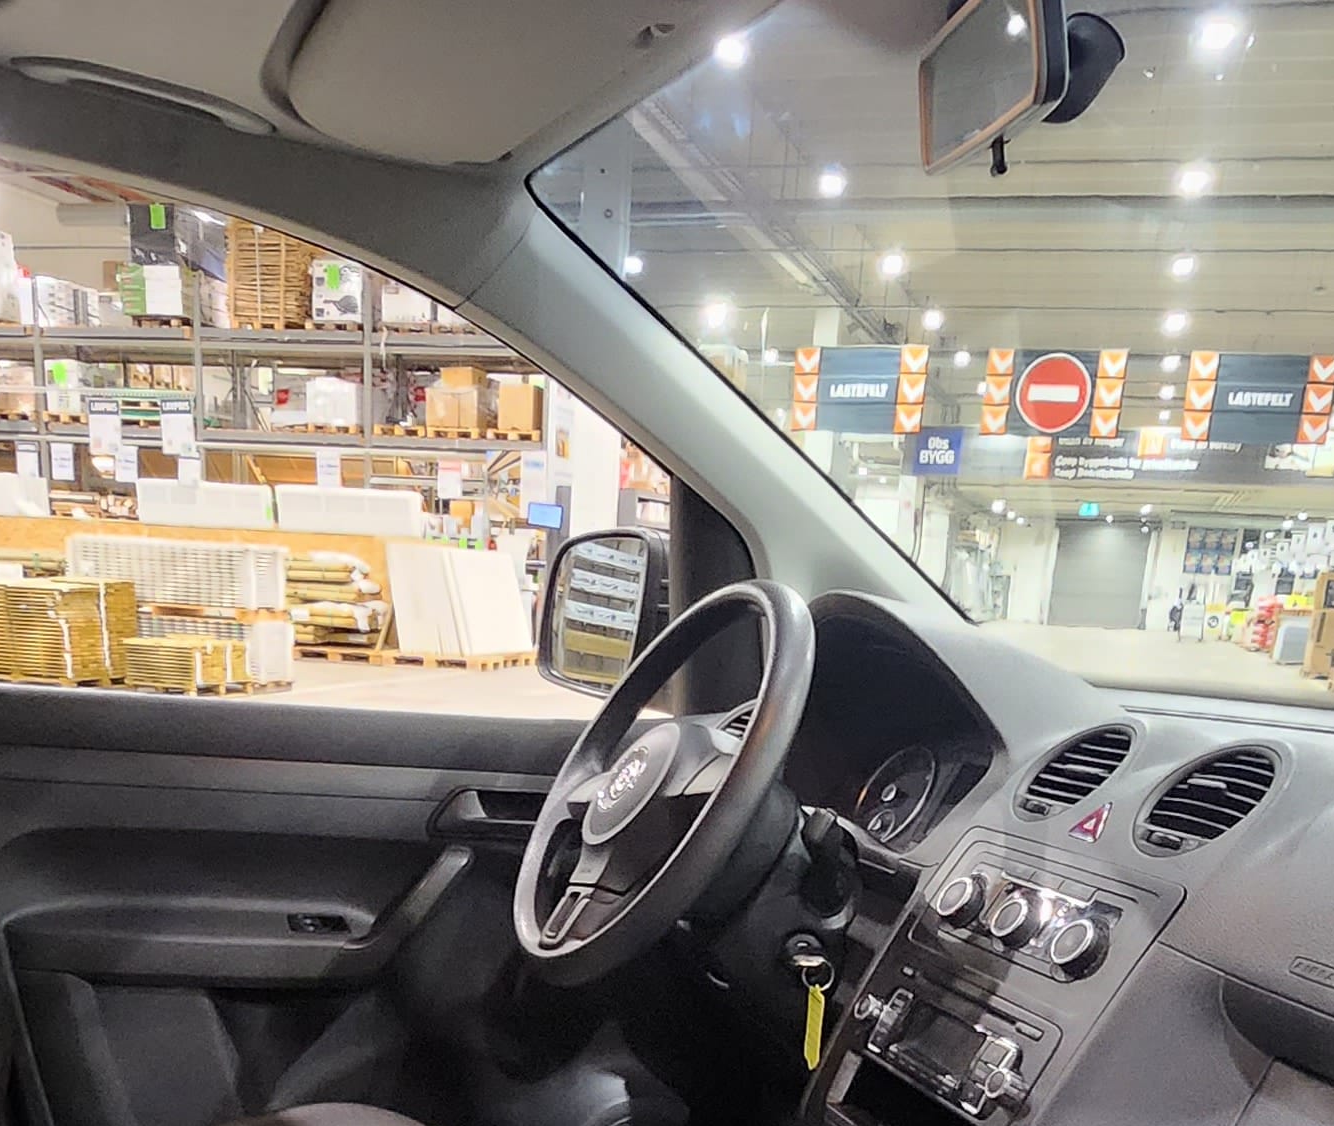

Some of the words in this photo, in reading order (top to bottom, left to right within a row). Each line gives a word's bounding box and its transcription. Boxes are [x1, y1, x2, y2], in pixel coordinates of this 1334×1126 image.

[1227, 391, 1294, 408] LASTEFELT
[927, 436, 949, 450] Obs
[919, 450, 955, 465] BYGG
